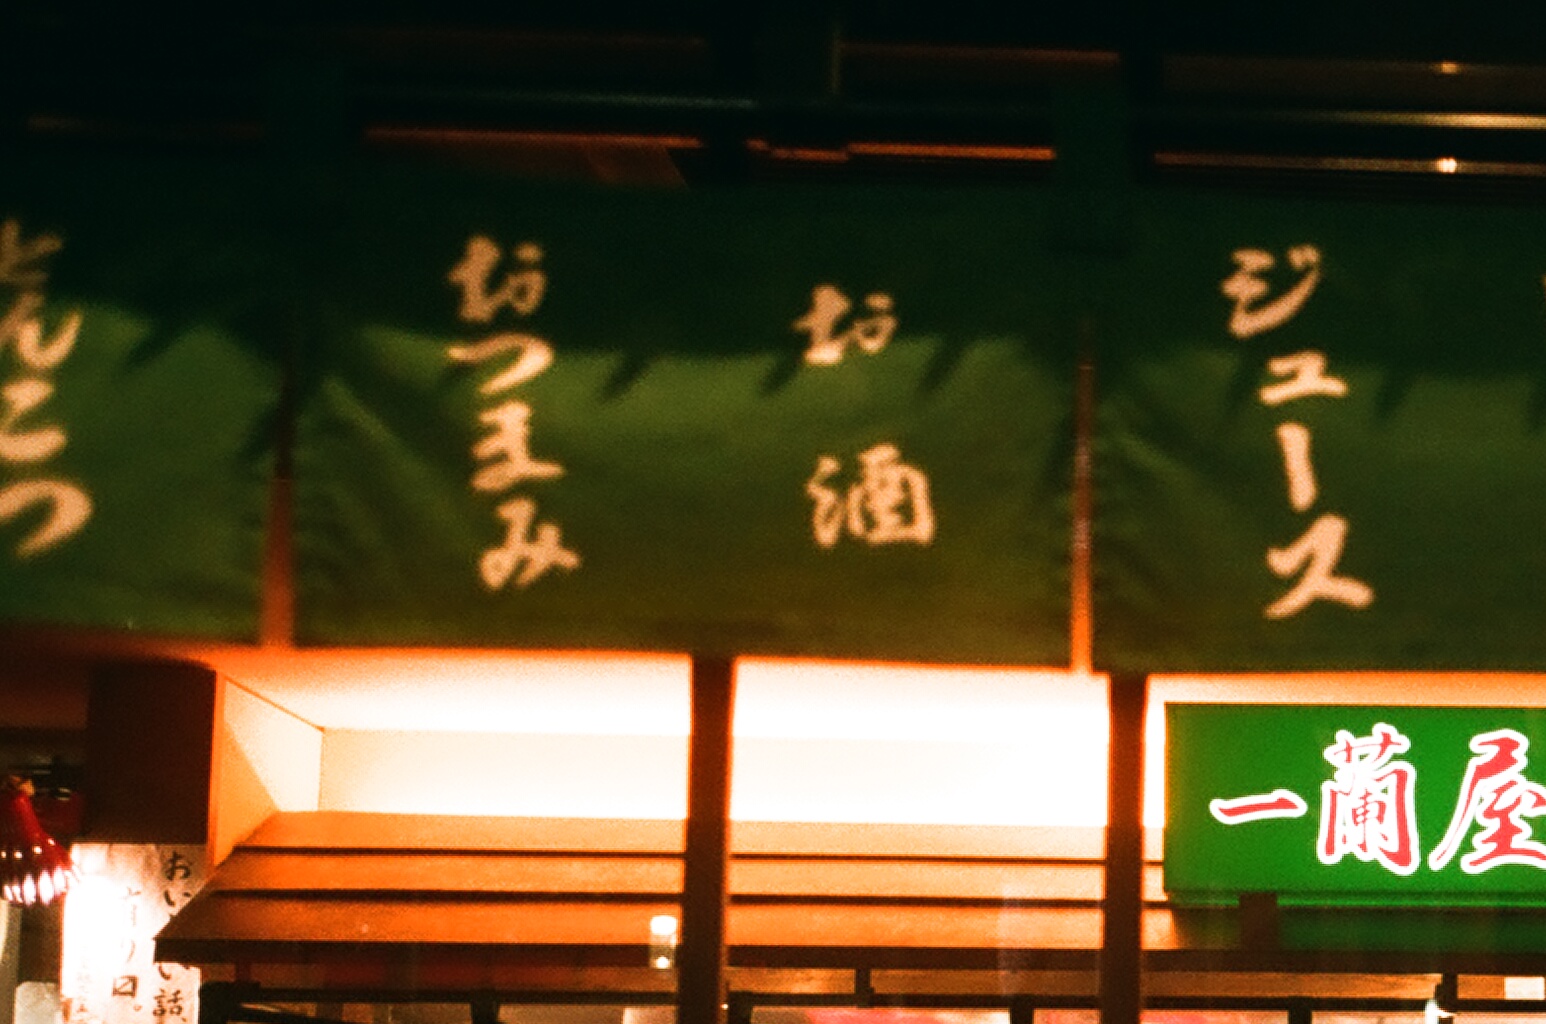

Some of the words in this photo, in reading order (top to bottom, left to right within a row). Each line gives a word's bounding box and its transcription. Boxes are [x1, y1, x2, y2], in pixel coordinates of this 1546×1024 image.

[447, 235, 581, 591] おつまみ
[795, 285, 937, 549] お酒
[1221, 245, 1374, 619] ジュース
